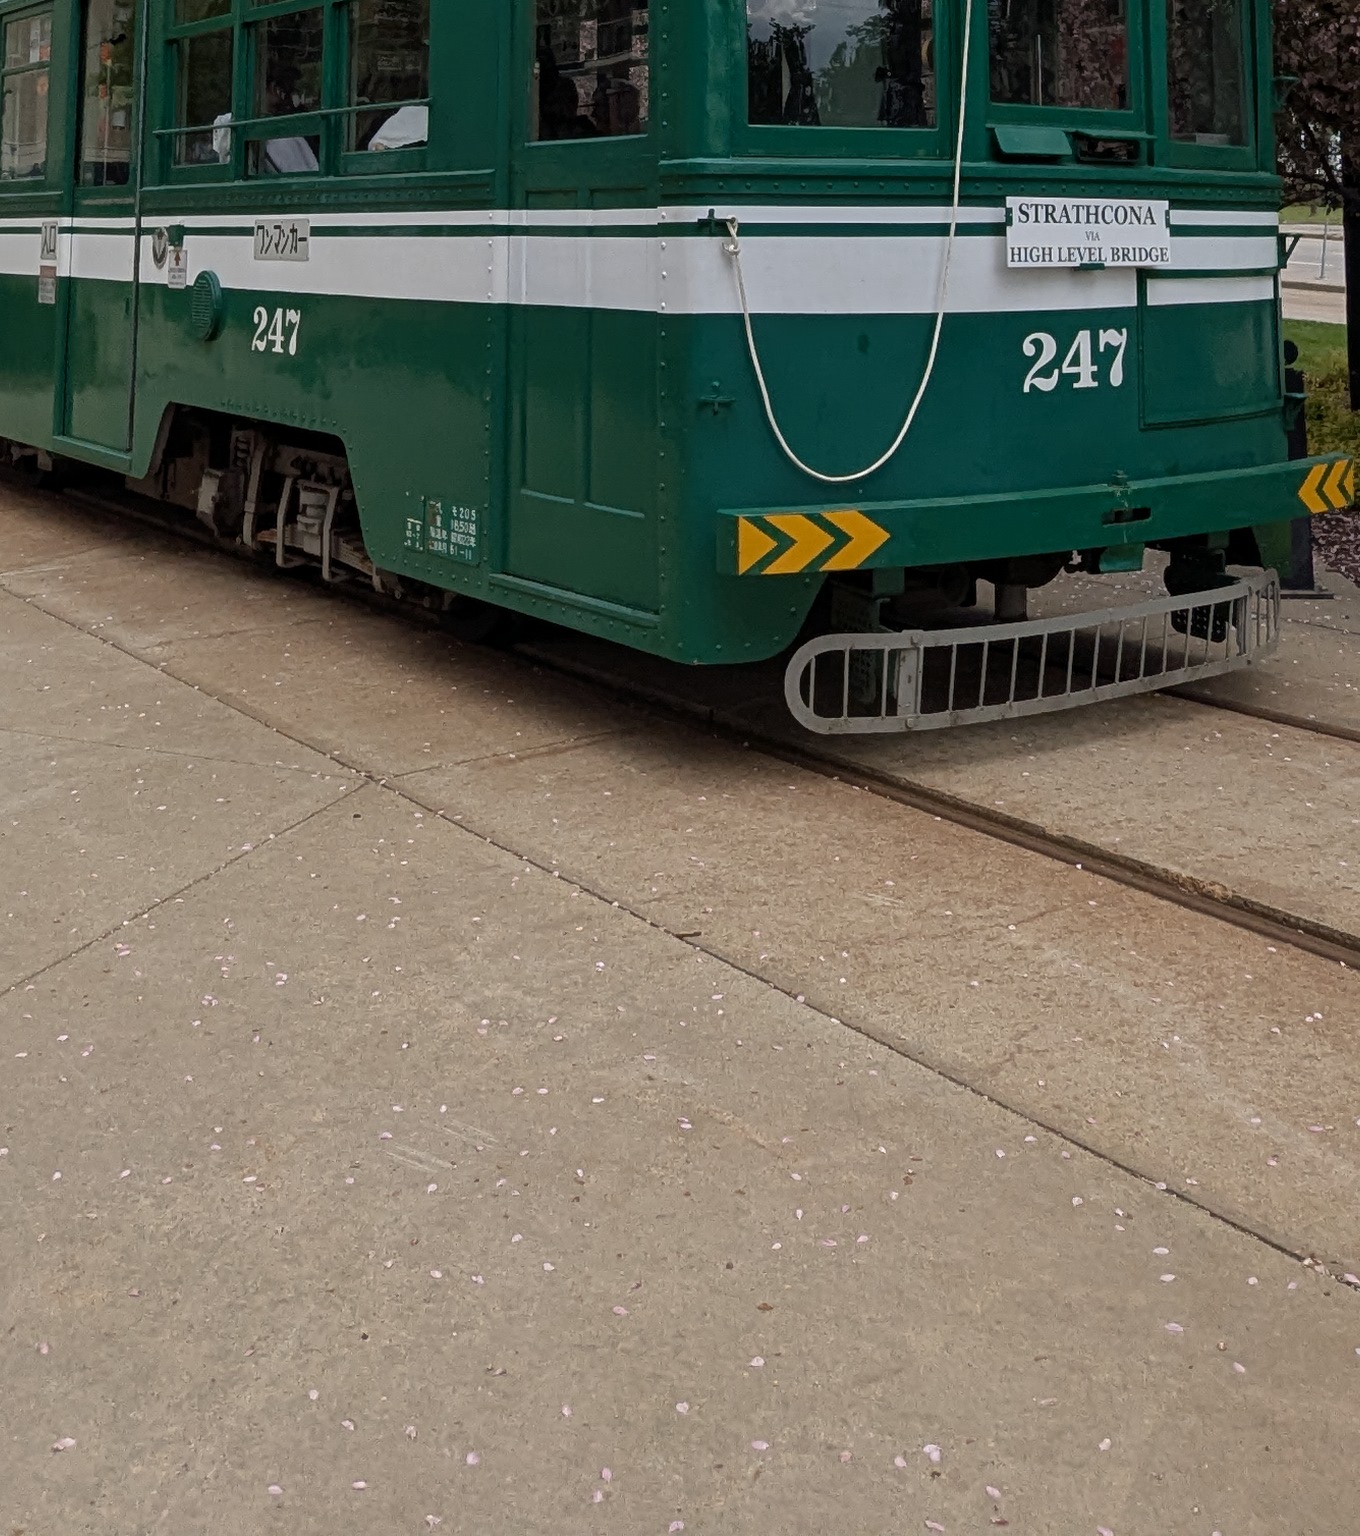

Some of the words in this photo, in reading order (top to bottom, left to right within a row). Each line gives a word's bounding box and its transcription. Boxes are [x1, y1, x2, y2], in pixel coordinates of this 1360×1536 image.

[1018, 203, 1156, 225] STRATHCONA
[256, 223, 307, 254] ワンマンカー
[1085, 231, 1100, 241] VIA
[1010, 246, 1053, 263] HIGH
[1057, 247, 1107, 263] LEVEL
[1111, 247, 1169, 263] BRIDGE
[251, 306, 301, 356] 247
[1022, 328, 1127, 393] 247
